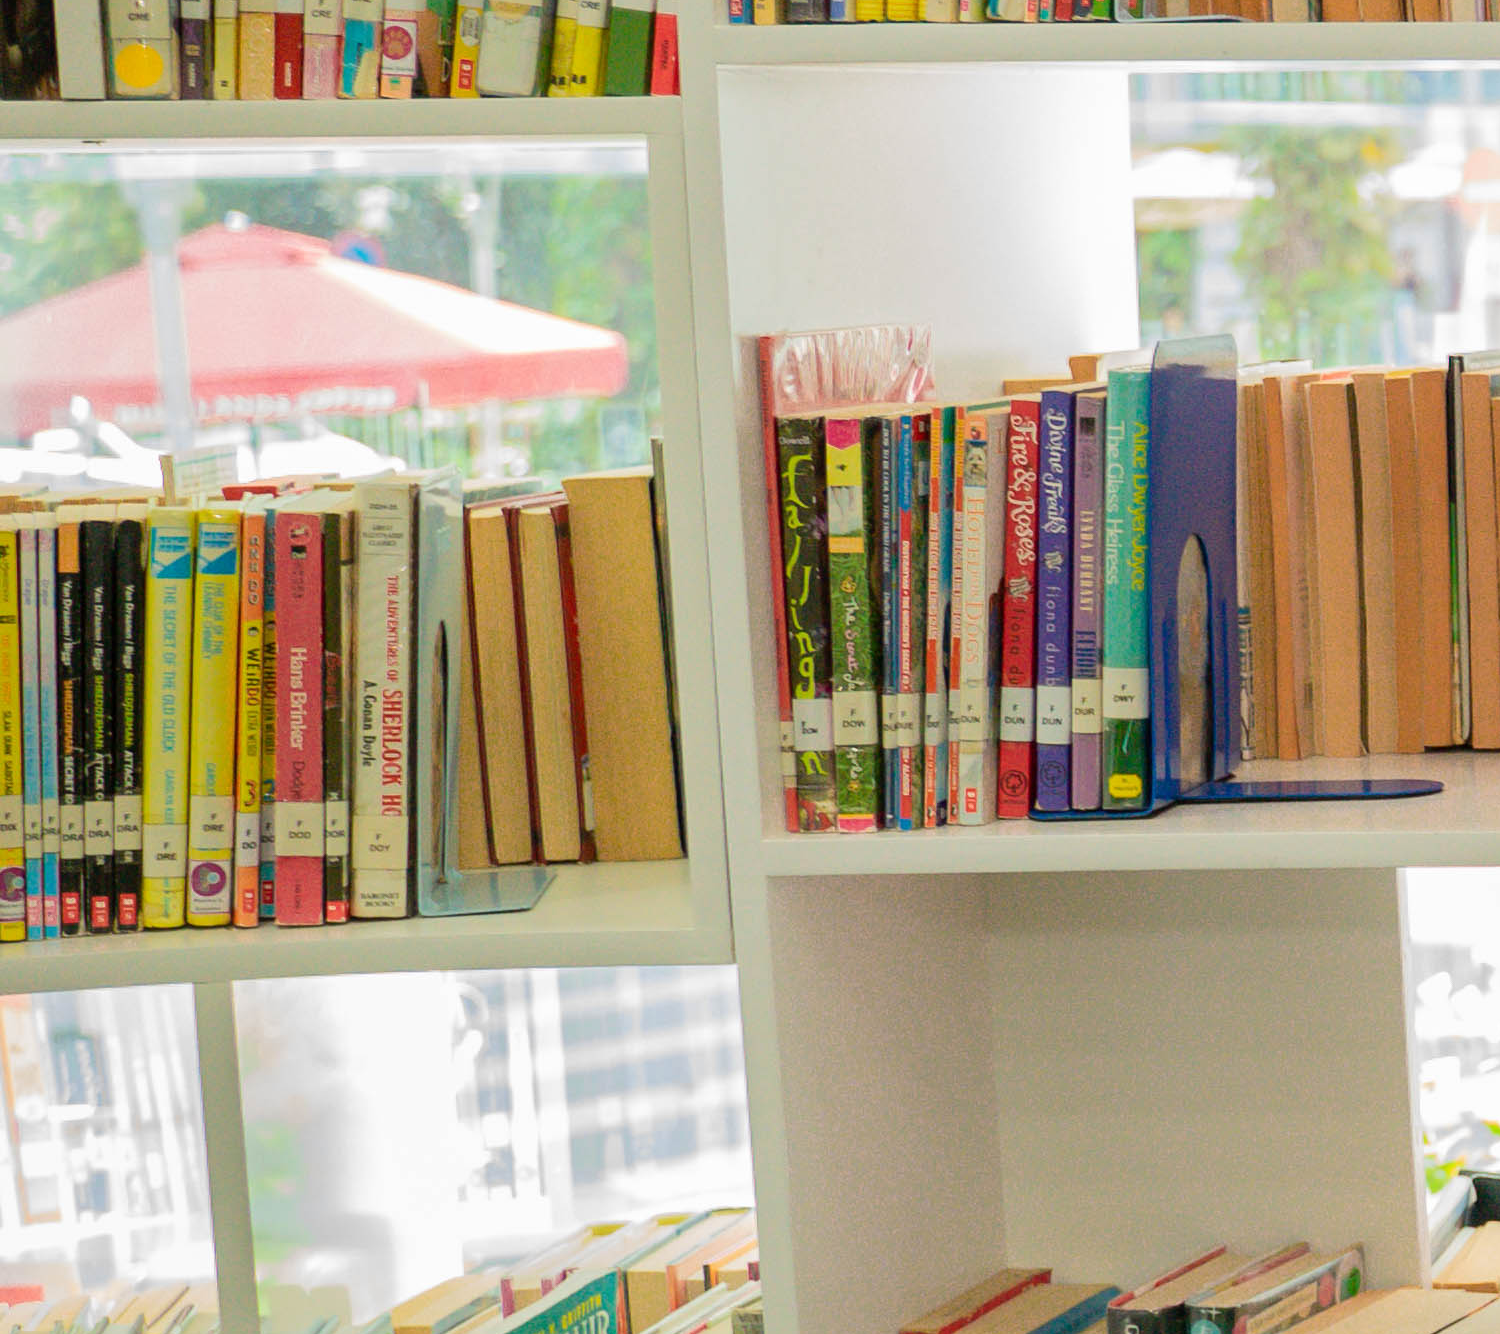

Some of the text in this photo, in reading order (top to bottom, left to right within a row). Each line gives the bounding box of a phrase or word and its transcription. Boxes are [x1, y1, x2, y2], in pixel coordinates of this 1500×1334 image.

[1008, 415, 1037, 565] Fire & Roses
[1041, 411, 1069, 535] Divine Freaks
[1105, 421, 1126, 584] The Glass Heiress
[289, 647, 307, 752] Hans Brinker
[360, 679, 376, 768] A. Conan Doyle
[382, 689, 403, 786] SHERLOCK
